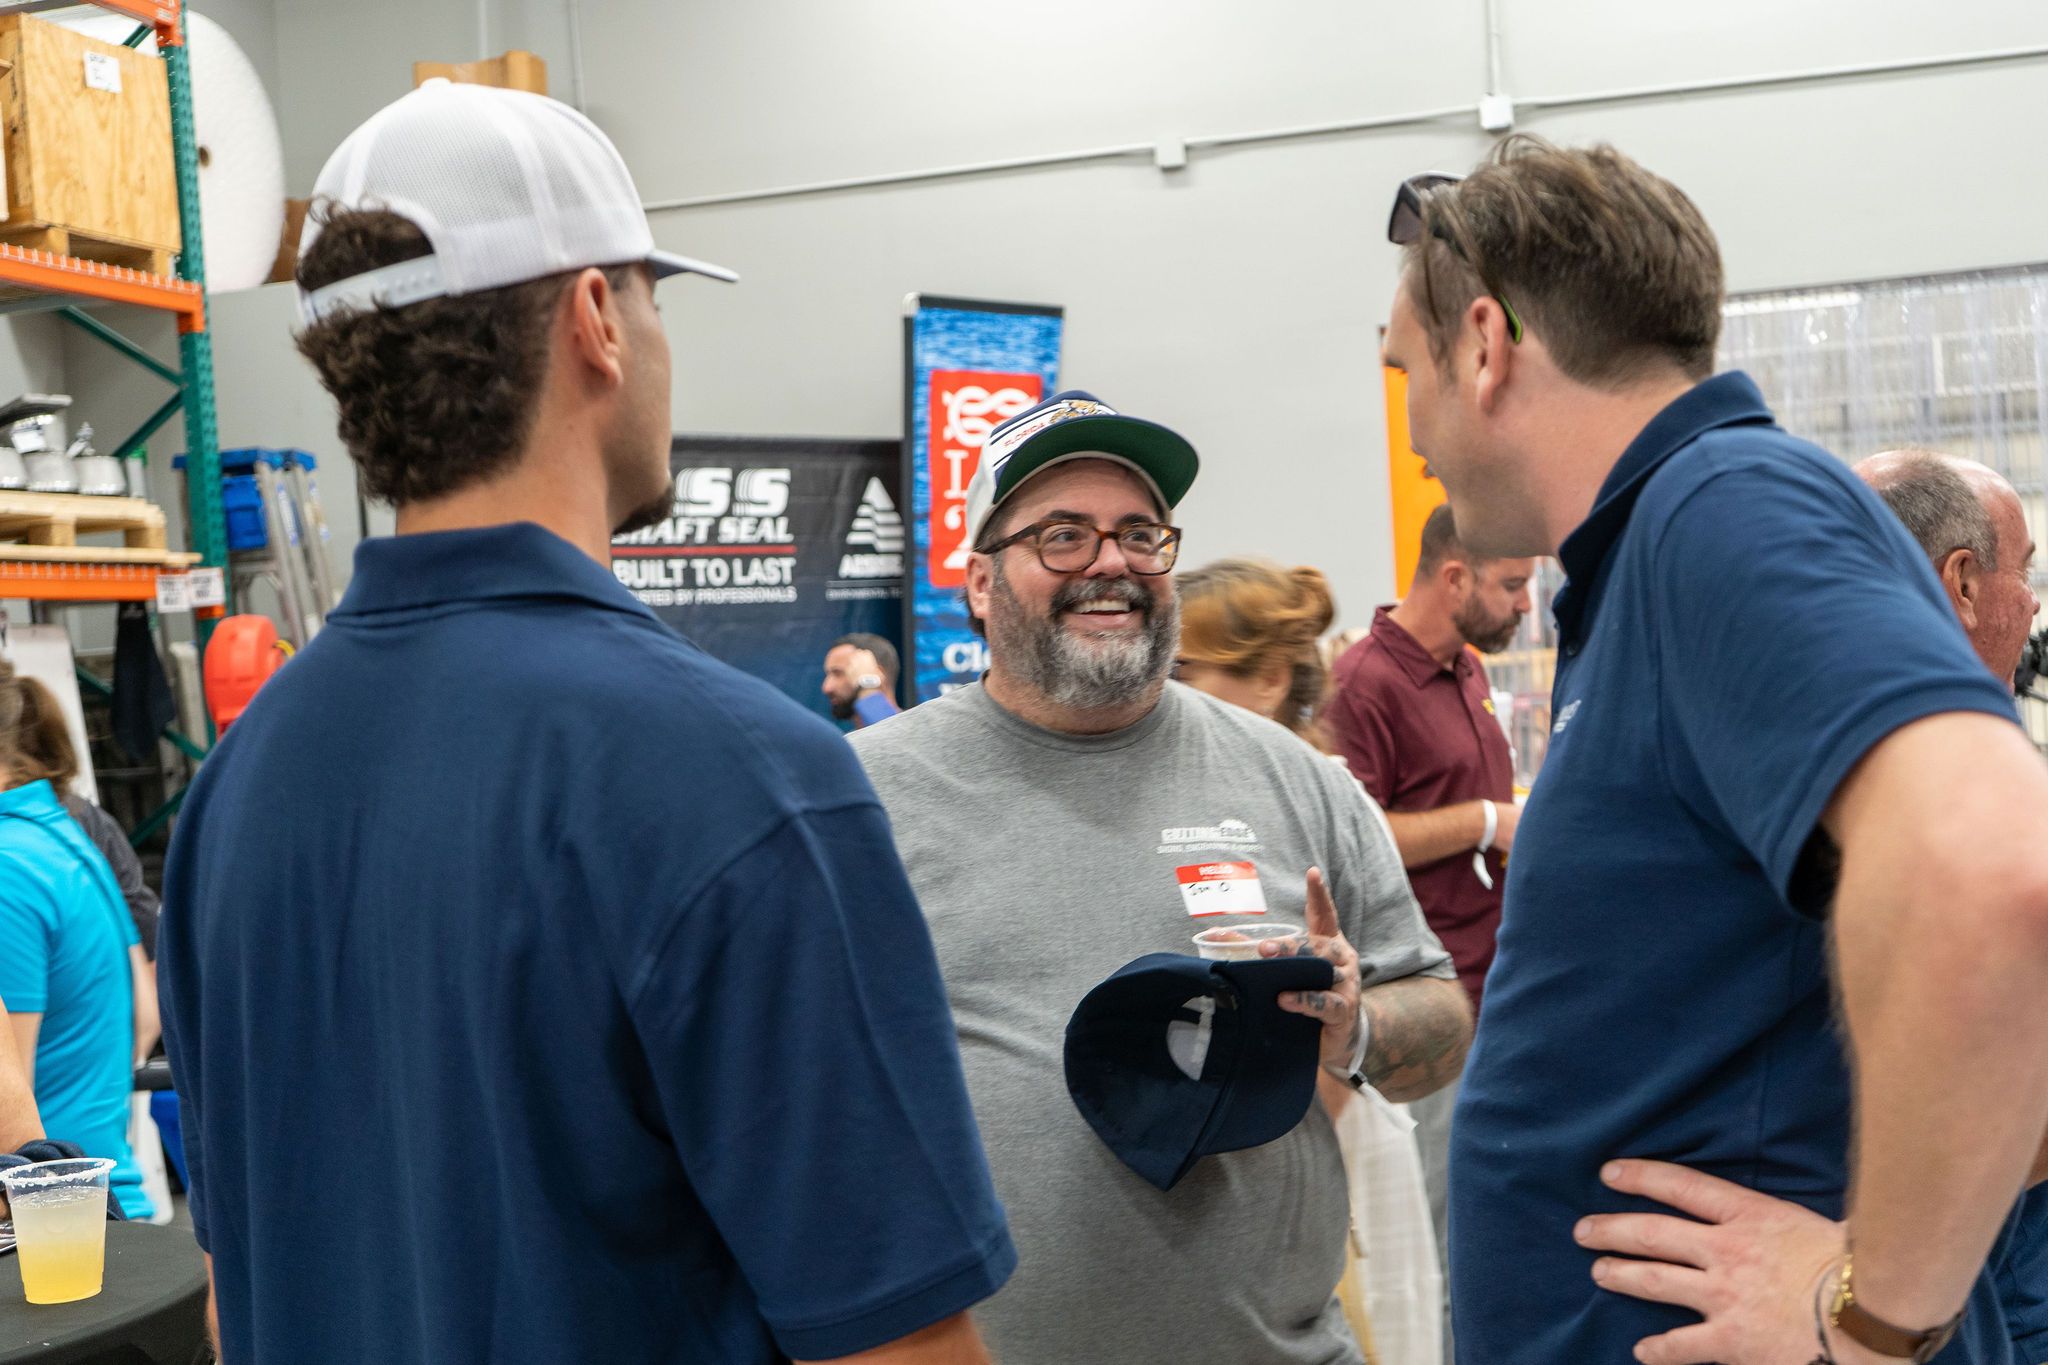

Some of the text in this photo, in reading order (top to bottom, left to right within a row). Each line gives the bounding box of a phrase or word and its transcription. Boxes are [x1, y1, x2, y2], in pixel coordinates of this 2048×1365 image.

[673, 467, 791, 517] SS
[717, 516, 794, 544] SEAL
[612, 556, 797, 588] BUILT TO LAST
